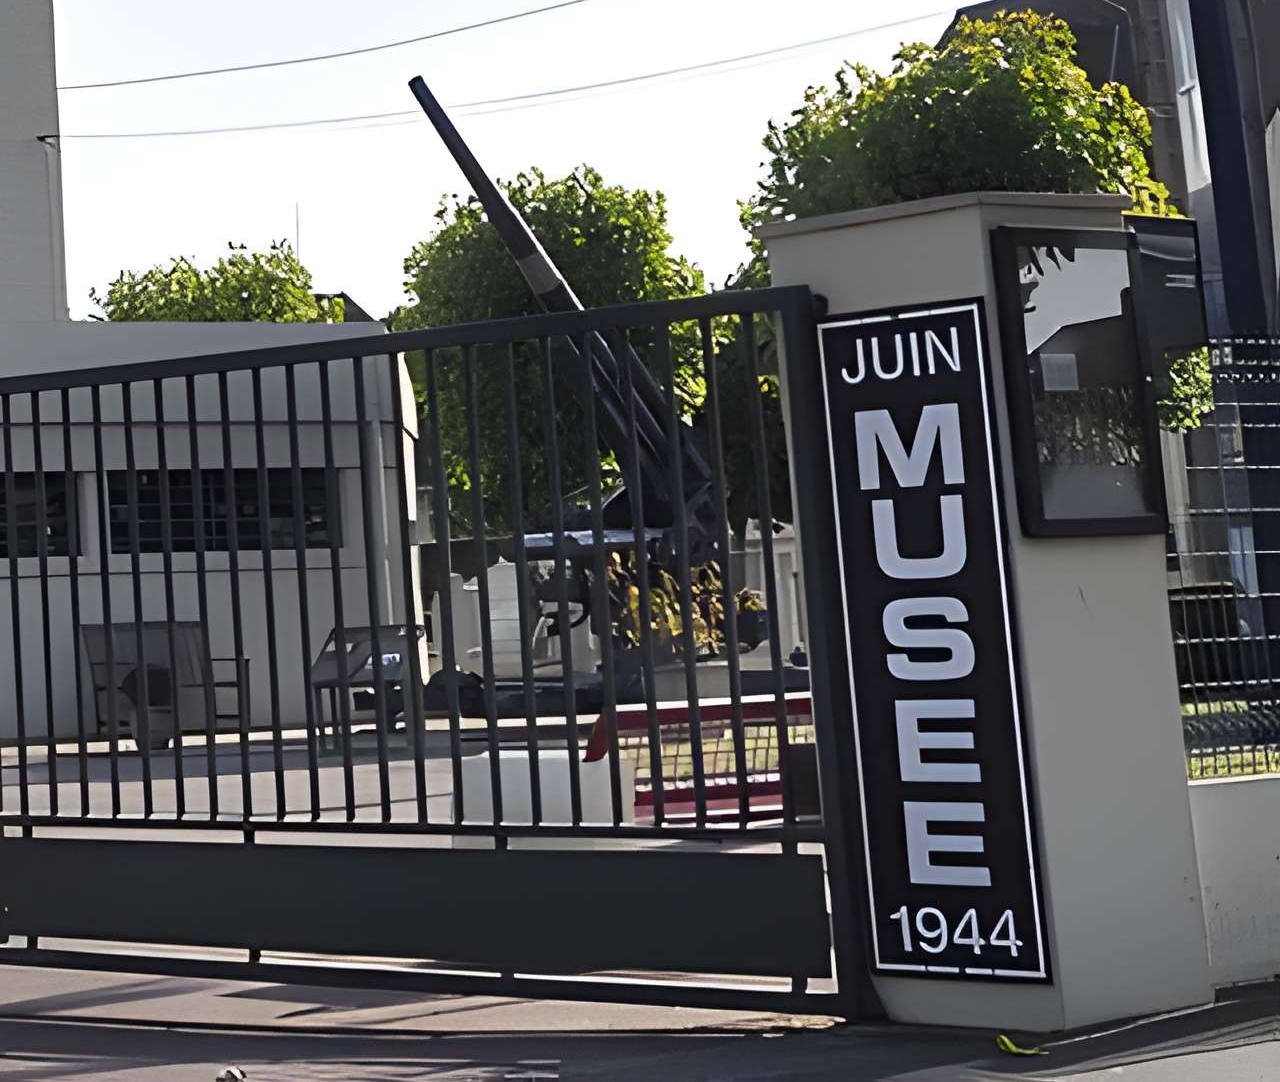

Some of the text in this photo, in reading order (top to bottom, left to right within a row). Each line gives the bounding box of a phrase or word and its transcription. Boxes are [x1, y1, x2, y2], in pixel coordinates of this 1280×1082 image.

[841, 325, 962, 384] JUIN
[853, 402, 992, 887] MUSEE
[889, 905, 1023, 958] 1944
